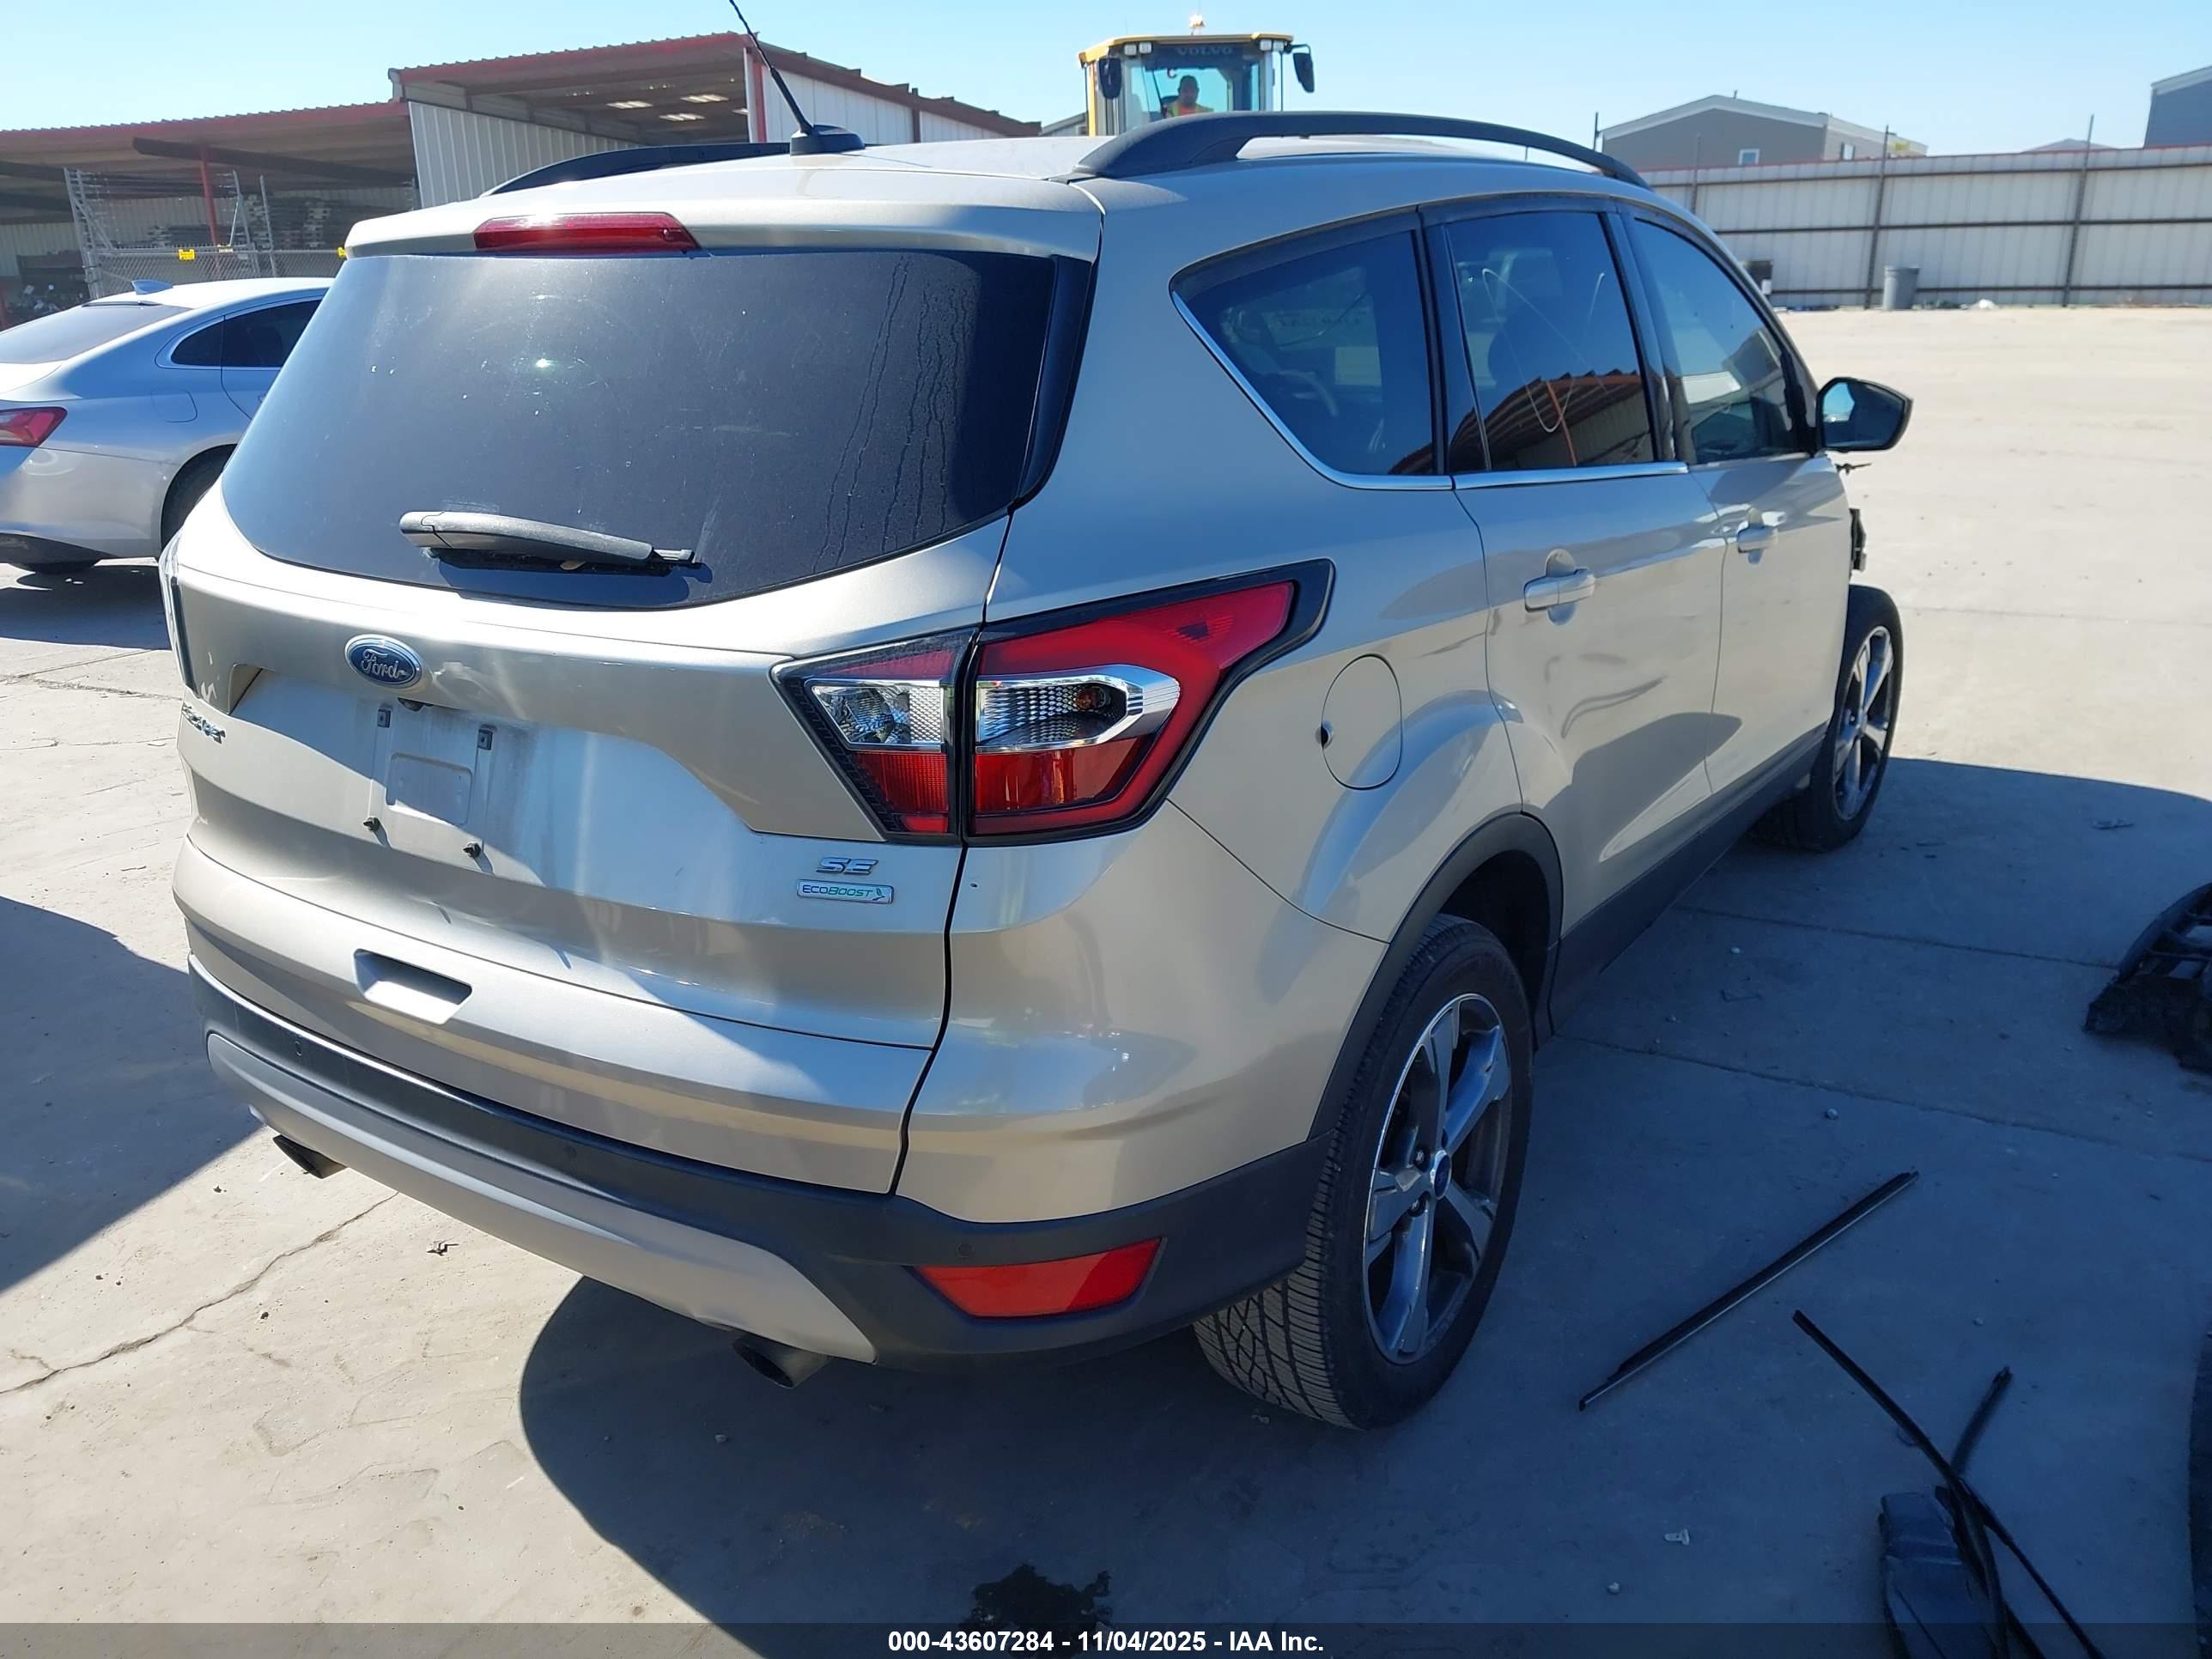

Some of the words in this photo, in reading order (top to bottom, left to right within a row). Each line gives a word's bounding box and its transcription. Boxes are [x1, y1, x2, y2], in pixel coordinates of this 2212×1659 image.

[1177, 46, 1232, 56] VOLVO
[361, 648, 402, 678] Ford
[815, 856, 879, 875] SE
